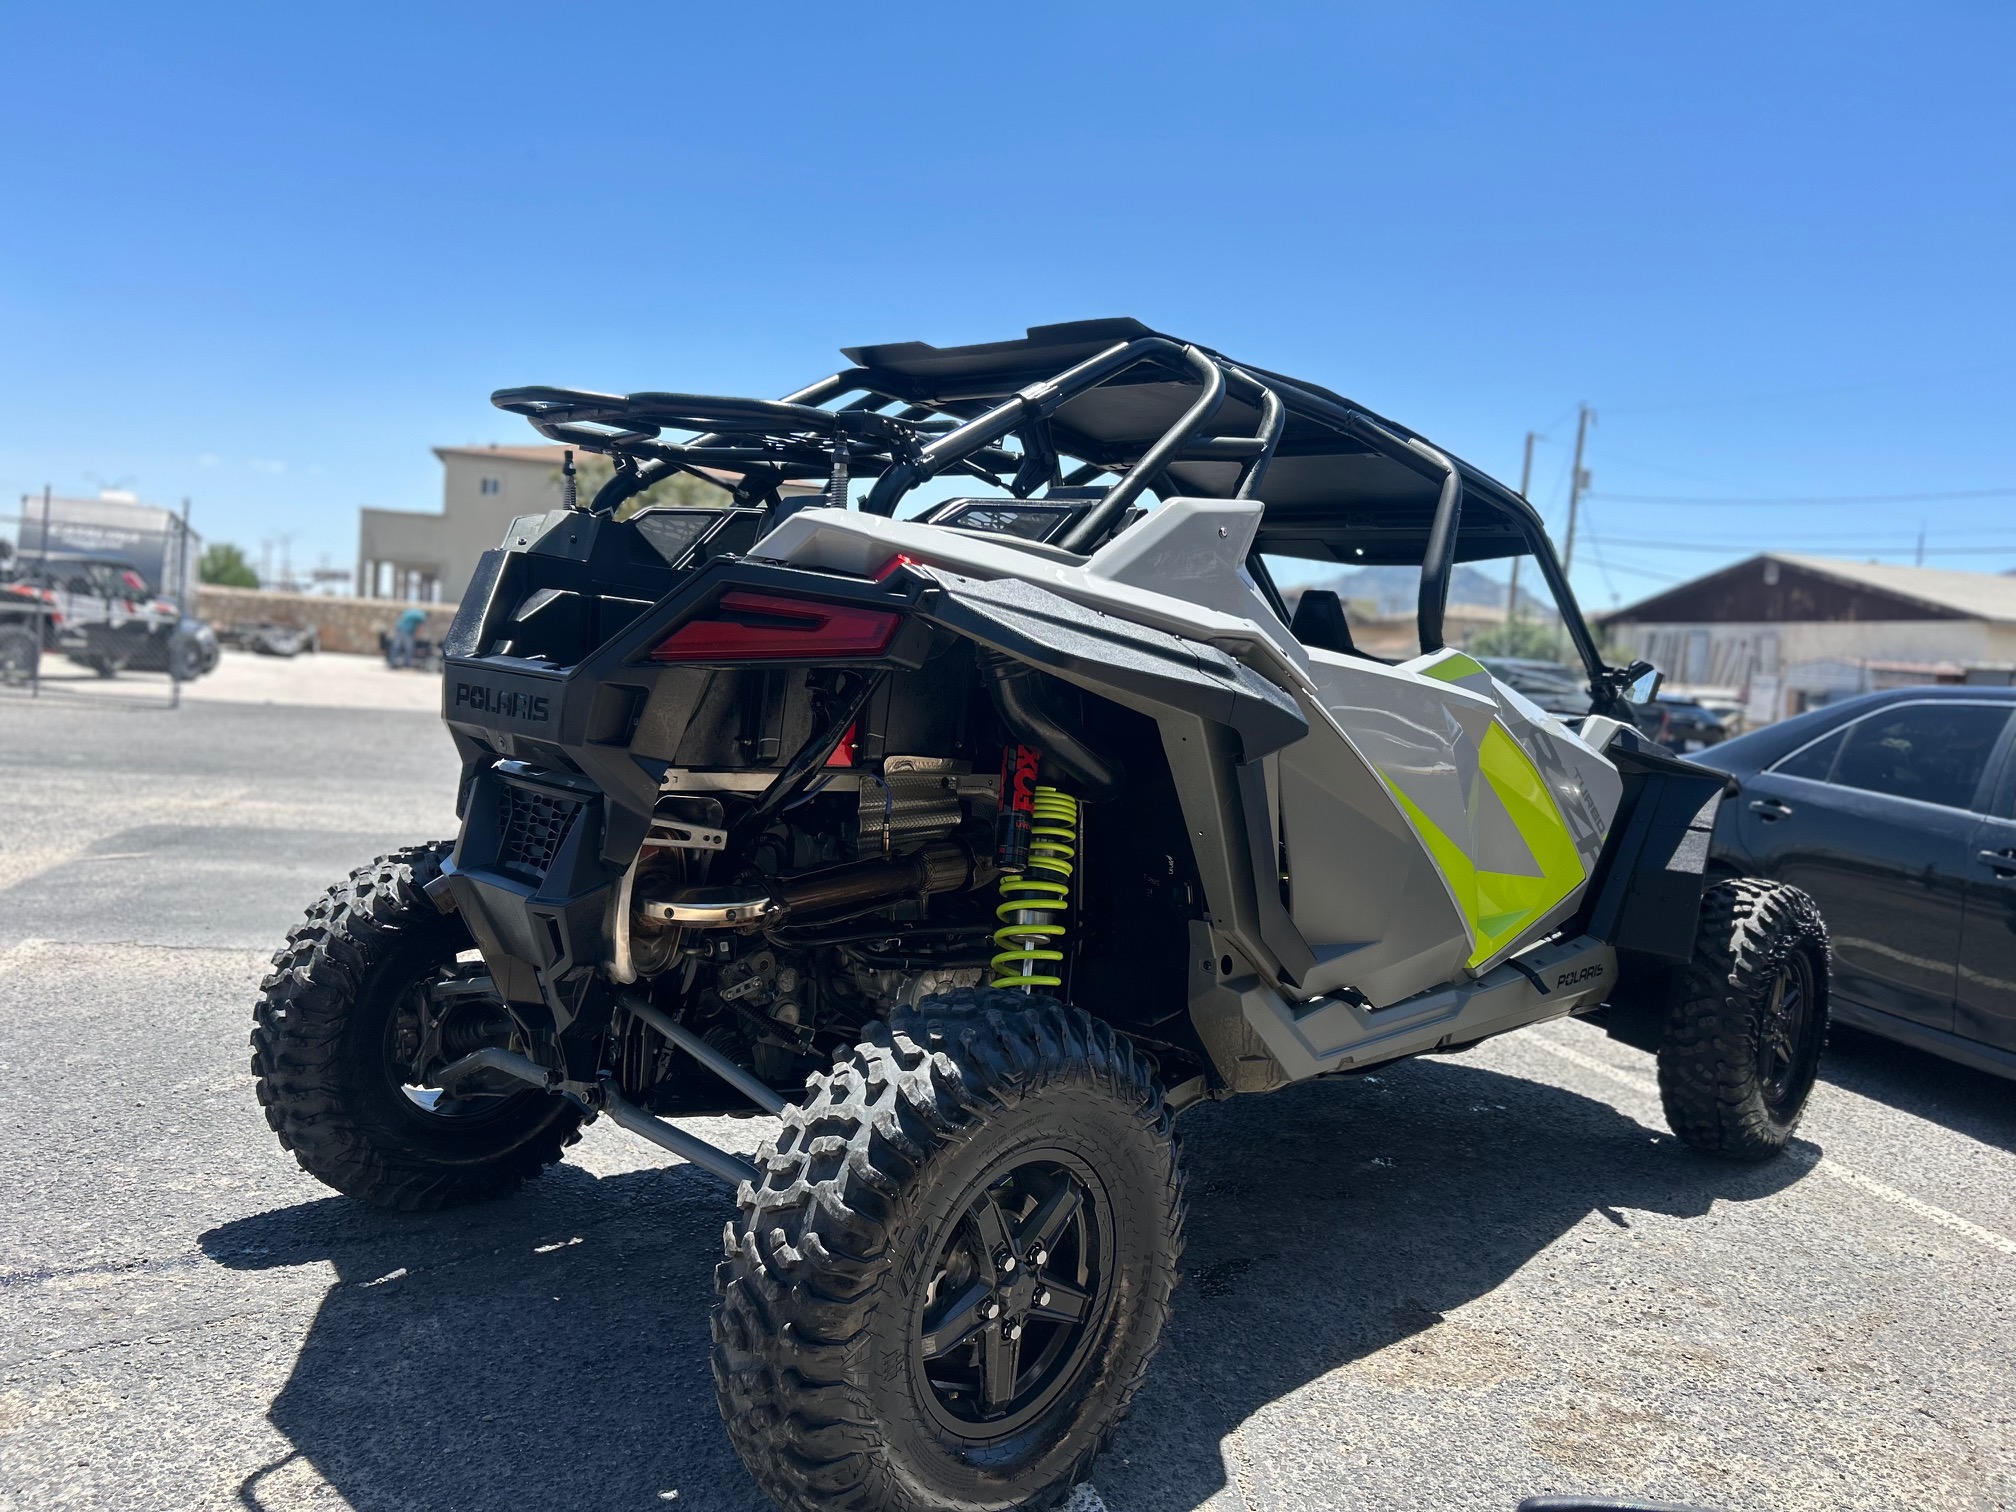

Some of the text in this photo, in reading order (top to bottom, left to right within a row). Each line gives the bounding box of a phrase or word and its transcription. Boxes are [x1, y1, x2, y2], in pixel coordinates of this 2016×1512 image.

[456, 683, 549, 722] POLARIS
[1574, 766, 1606, 835] TURBO
[1557, 963, 1603, 989] POLARIS
